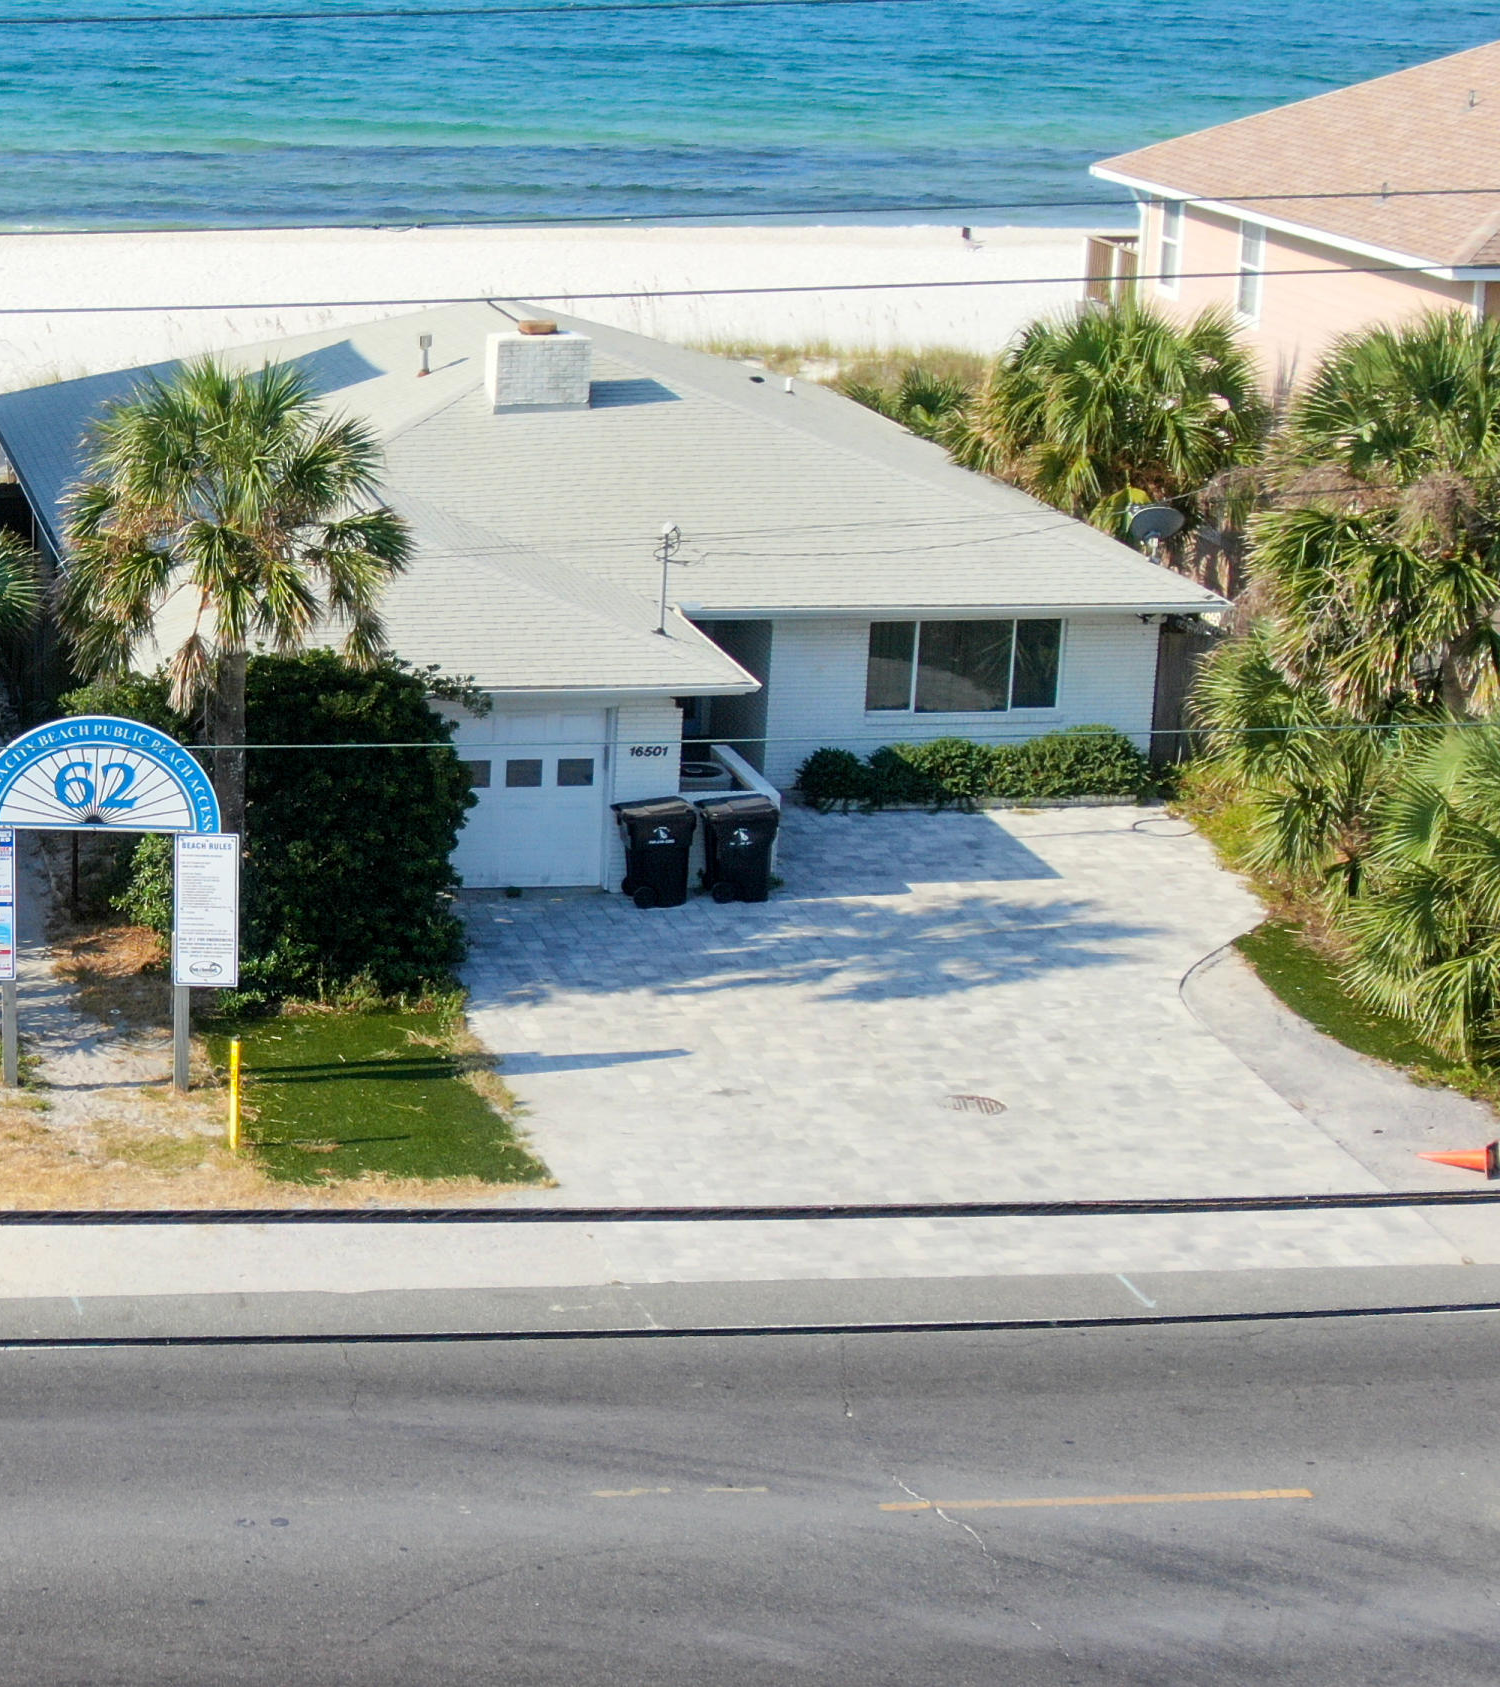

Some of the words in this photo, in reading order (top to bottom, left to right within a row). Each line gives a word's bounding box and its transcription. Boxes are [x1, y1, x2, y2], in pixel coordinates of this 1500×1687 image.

[629, 745, 669, 757] 16501
[5, 742, 38, 770] CITY
[37, 724, 90, 748] BEACH
[93, 724, 150, 746] PUBLIC
[150, 740, 194, 781] BEACH
[190, 778, 214, 832] ACCESS
[54, 760, 140, 809] 62
[181, 842, 207, 850] BEACH
[208, 842, 233, 851] RULES
